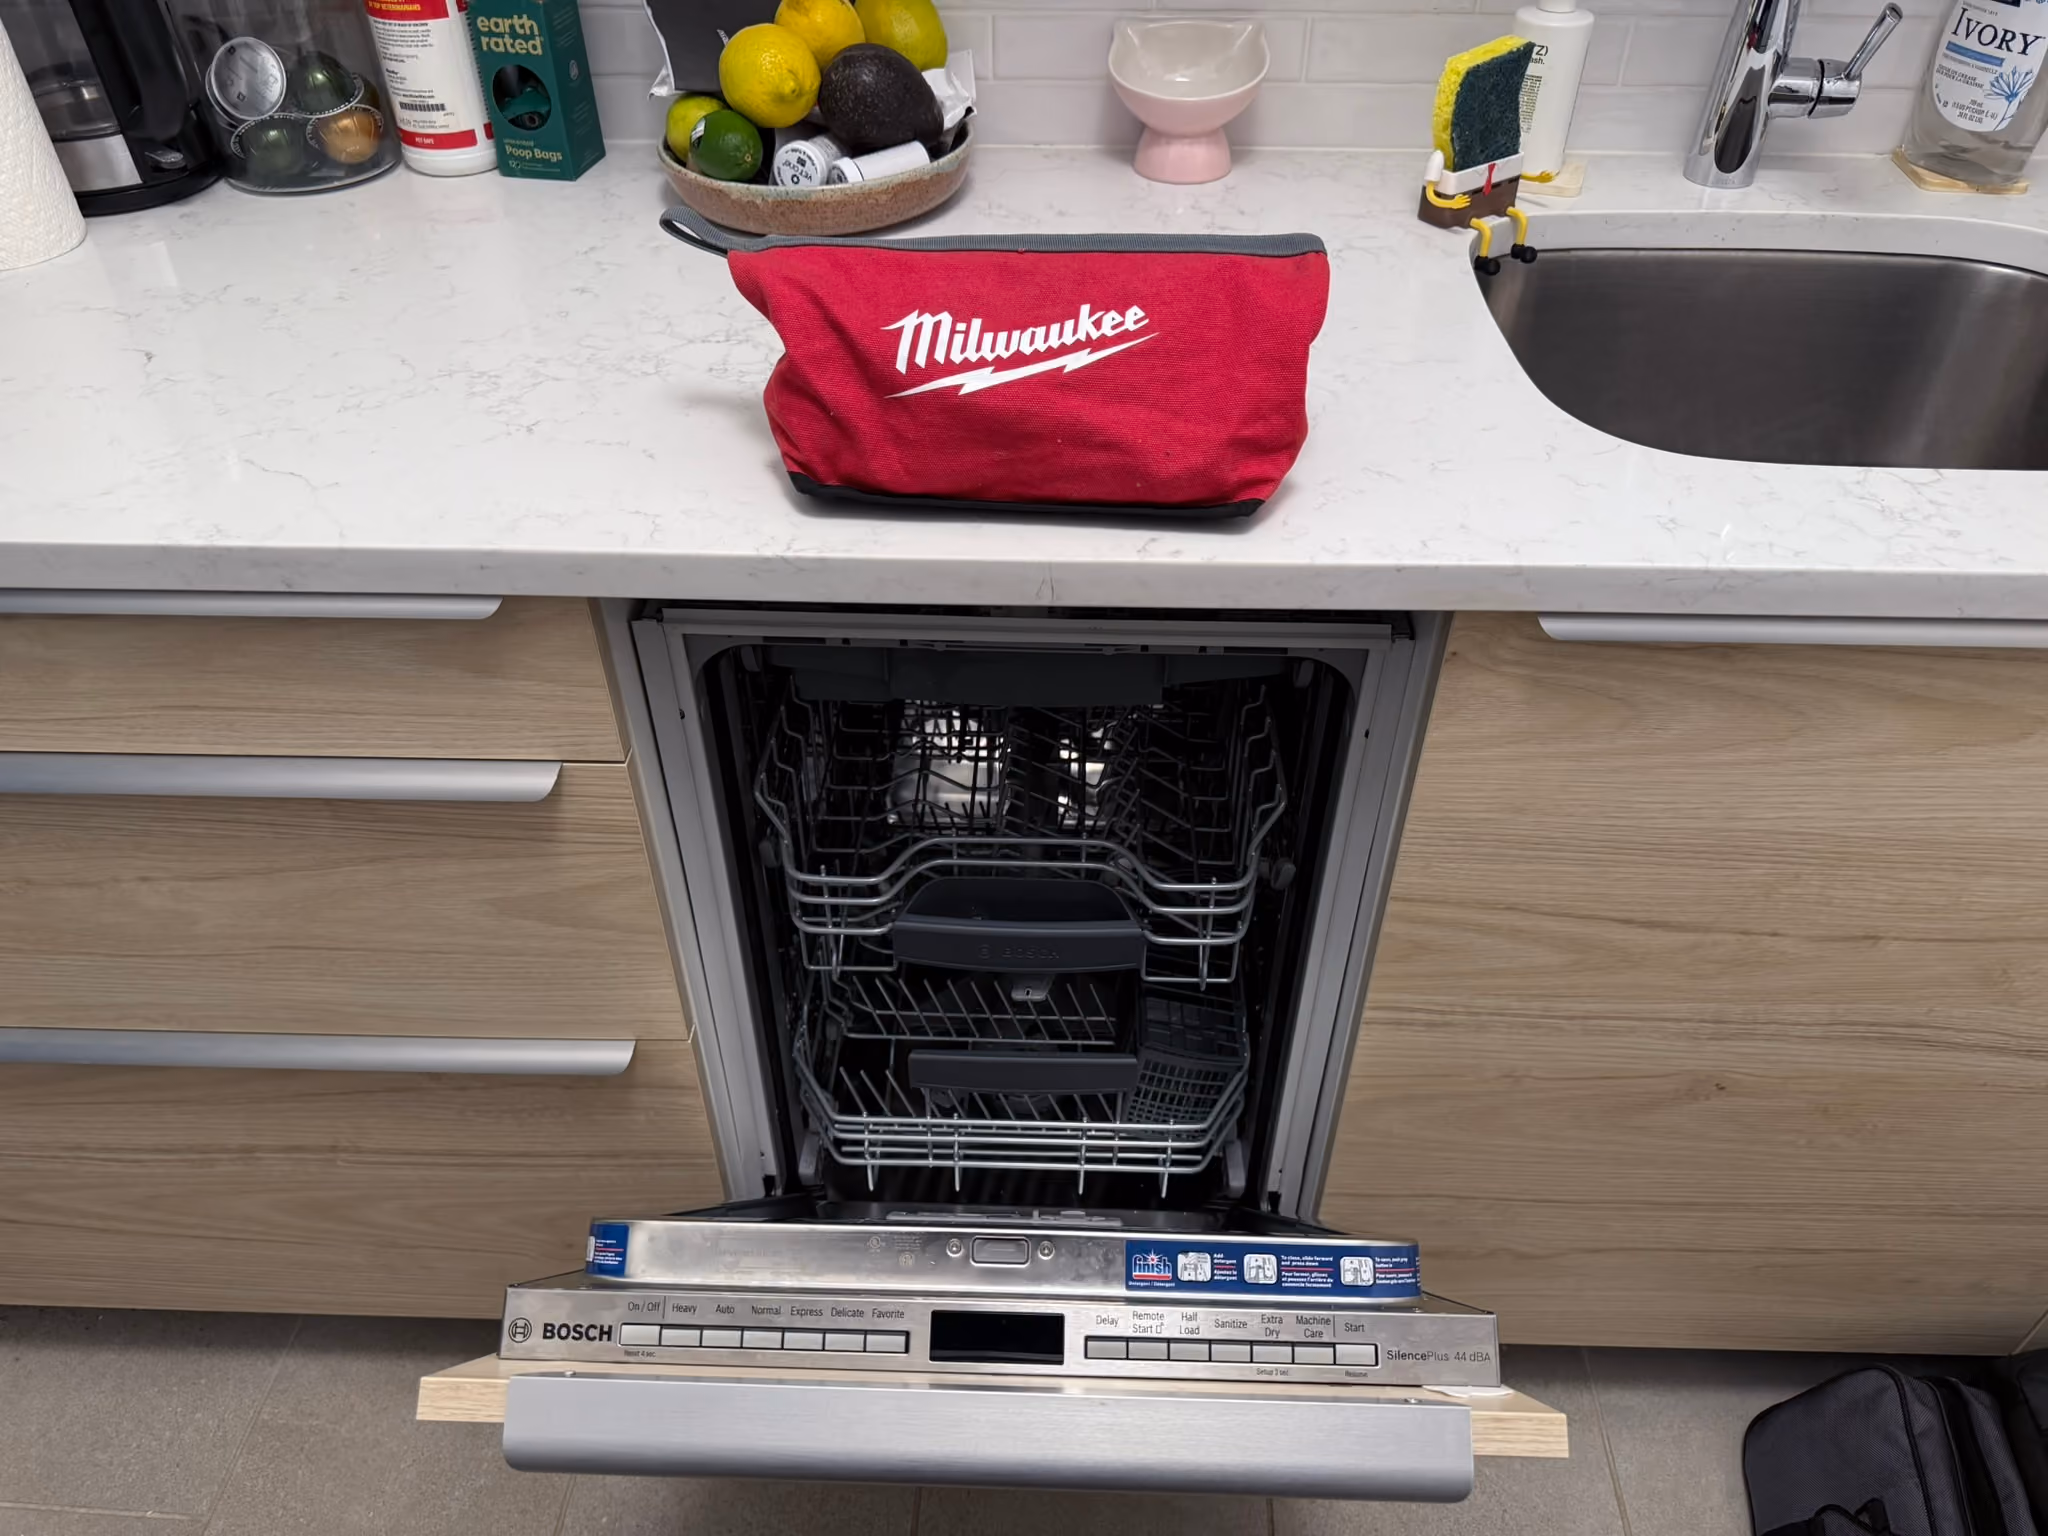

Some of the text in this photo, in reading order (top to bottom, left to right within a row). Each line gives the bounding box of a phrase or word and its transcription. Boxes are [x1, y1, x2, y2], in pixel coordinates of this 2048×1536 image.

[477, 14, 539, 35] earth
[1951, 7, 2042, 56] IVORY
[481, 34, 543, 55] rated
[505, 145, 562, 162] Poop Bags
[880, 304, 1150, 375] Milwaukee
[1132, 1254, 1172, 1274] finish
[628, 1302, 640, 1312] On
[647, 1301, 661, 1313] Off
[672, 1303, 698, 1314] Heavy
[715, 1304, 735, 1314] Auto
[751, 1305, 781, 1315] Normal
[790, 1306, 824, 1317] Express
[831, 1307, 865, 1318] Delicate
[872, 1308, 905, 1319] Favorite
[1132, 1311, 1165, 1321] Remote
[1181, 1312, 1198, 1322] Half
[1096, 1315, 1119, 1327] Delay
[1214, 1318, 1248, 1329] Sanitize
[1261, 1314, 1283, 1325] Extra
[1296, 1315, 1332, 1326] Machine
[542, 1322, 613, 1342] BOSCH
[1132, 1324, 1153, 1334] Start
[1179, 1325, 1200, 1335] Load
[1265, 1327, 1281, 1339] Dry
[1304, 1328, 1324, 1338] Care
[1344, 1322, 1365, 1333] Start
[1386, 1350, 1491, 1362] SilencePlus 44 dBA
[1256, 1368, 1273, 1377] Setup
